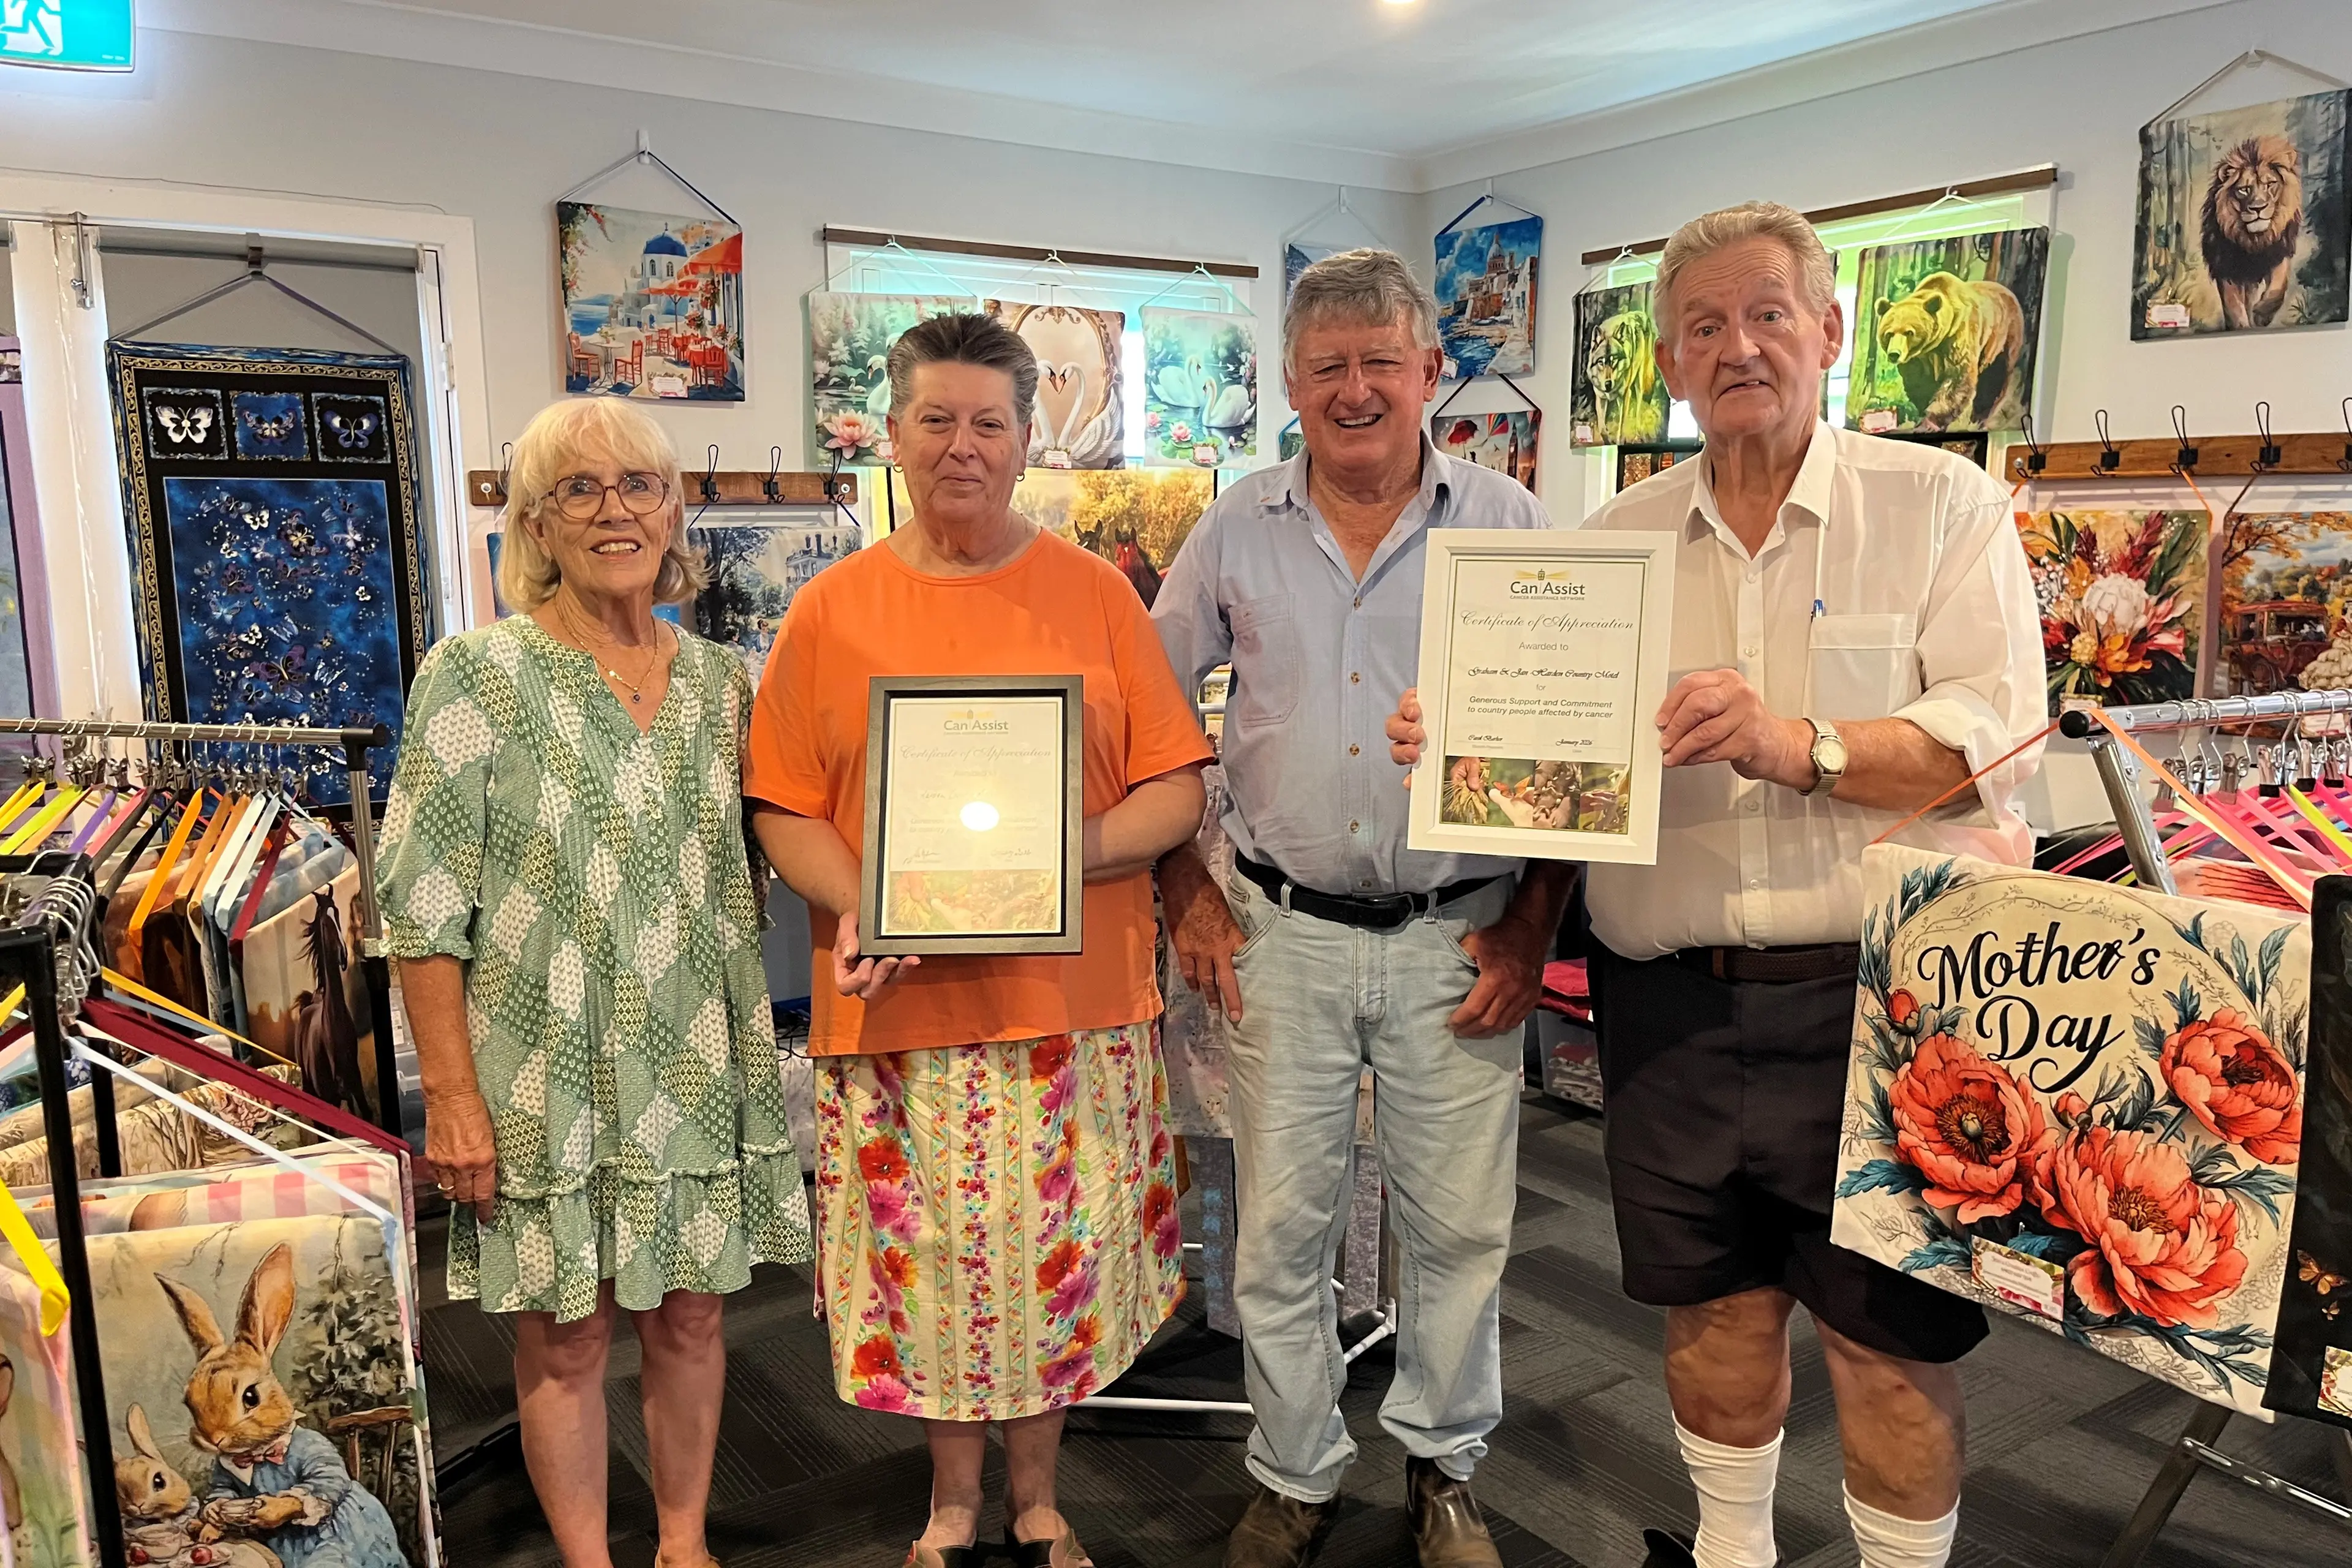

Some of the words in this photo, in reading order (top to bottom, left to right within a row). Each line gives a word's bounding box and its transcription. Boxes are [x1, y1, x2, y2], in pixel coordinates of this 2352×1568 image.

[1510, 581, 1537, 594] Can
[1542, 581, 1586, 595] Assist
[1460, 609, 1525, 631] Certificate
[1528, 614, 1545, 631] of
[1543, 613, 1634, 632] Appreciation
[1518, 642, 1557, 650] Awarded
[1509, 697, 1541, 706] Support
[1560, 699, 1612, 708] Commitment
[944, 720, 968, 730] Can
[971, 720, 1009, 730] Assist
[1917, 921, 2161, 1010] Mother's
[1975, 995, 2125, 1093] Day
